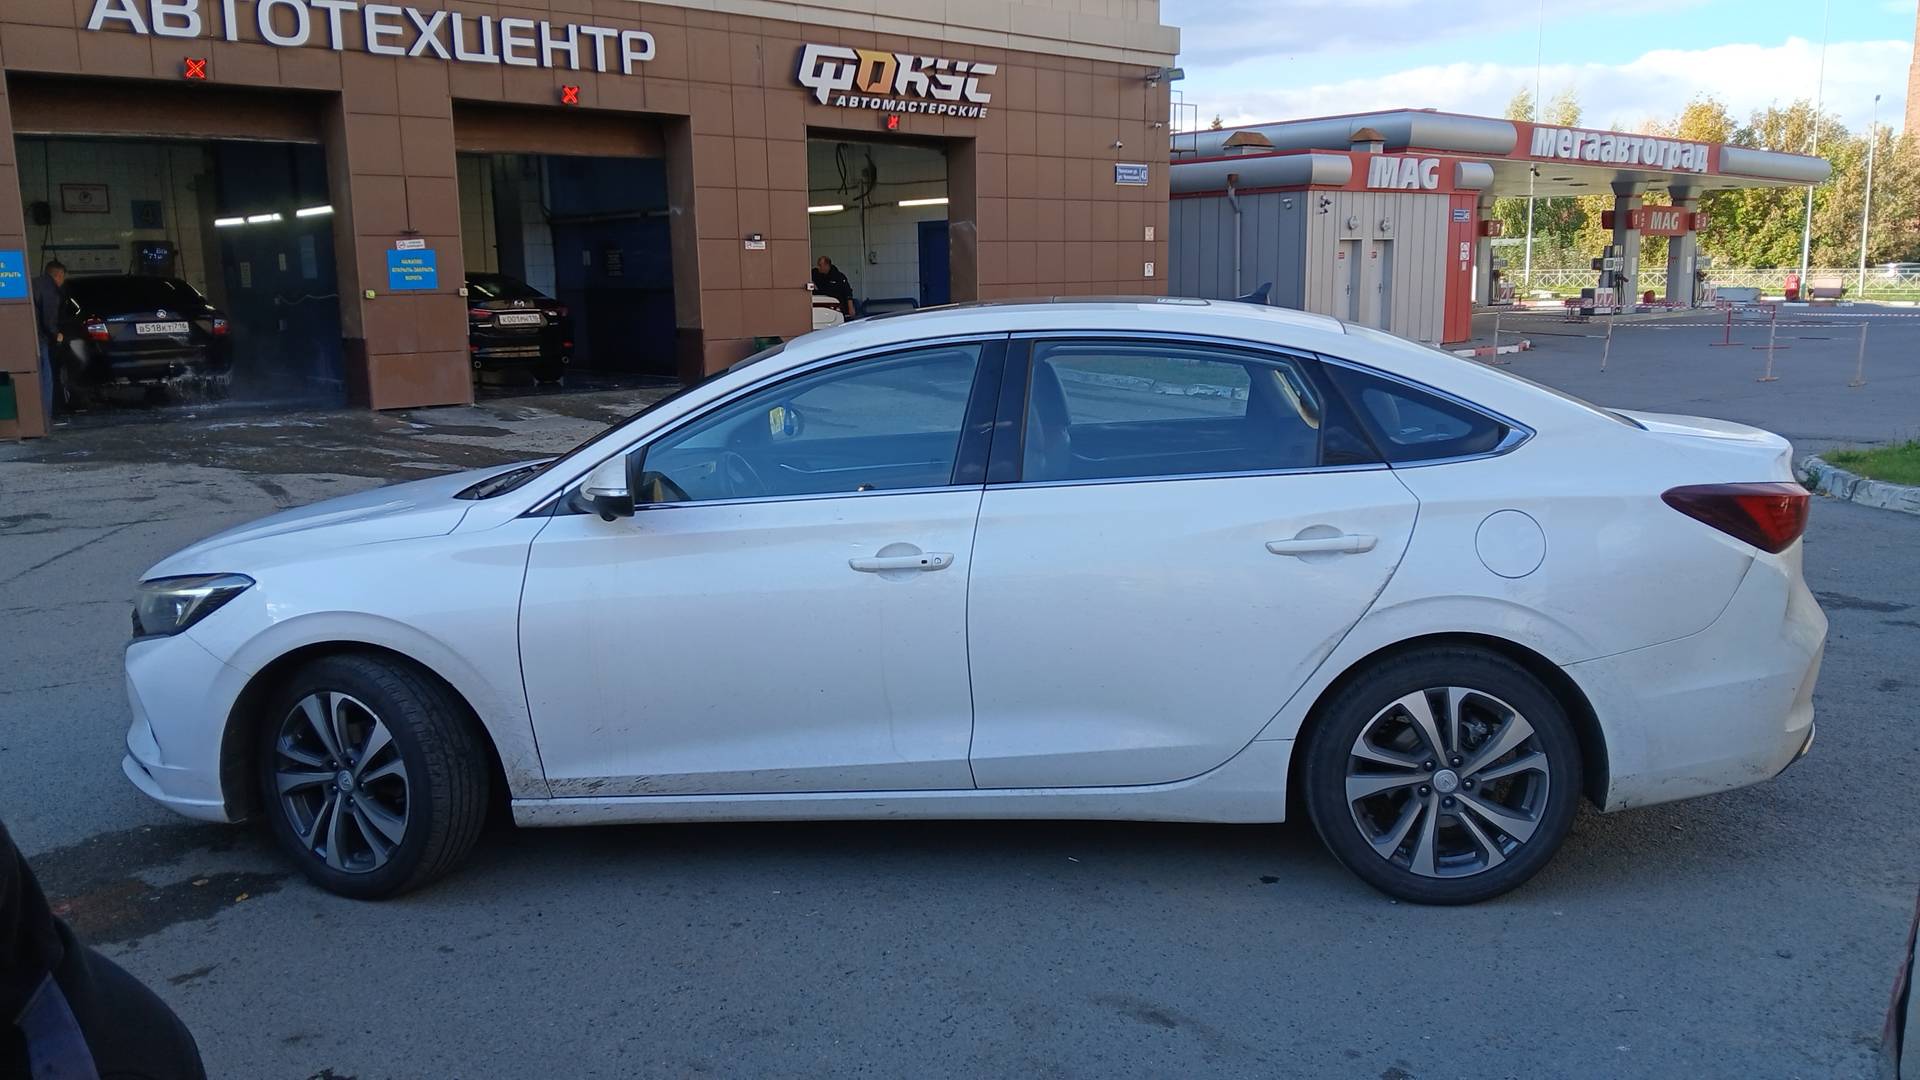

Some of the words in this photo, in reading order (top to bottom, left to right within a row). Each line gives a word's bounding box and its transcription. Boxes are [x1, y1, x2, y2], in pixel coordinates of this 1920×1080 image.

[87, 0, 656, 75] АВТОТЕХЦЕНТР
[797, 43, 998, 105] ФОКУС
[836, 95, 988, 119] АВТОМАСТЕРСКИЕ
[1367, 156, 1440, 190] MAG
[1650, 211, 1680, 230] MAG
